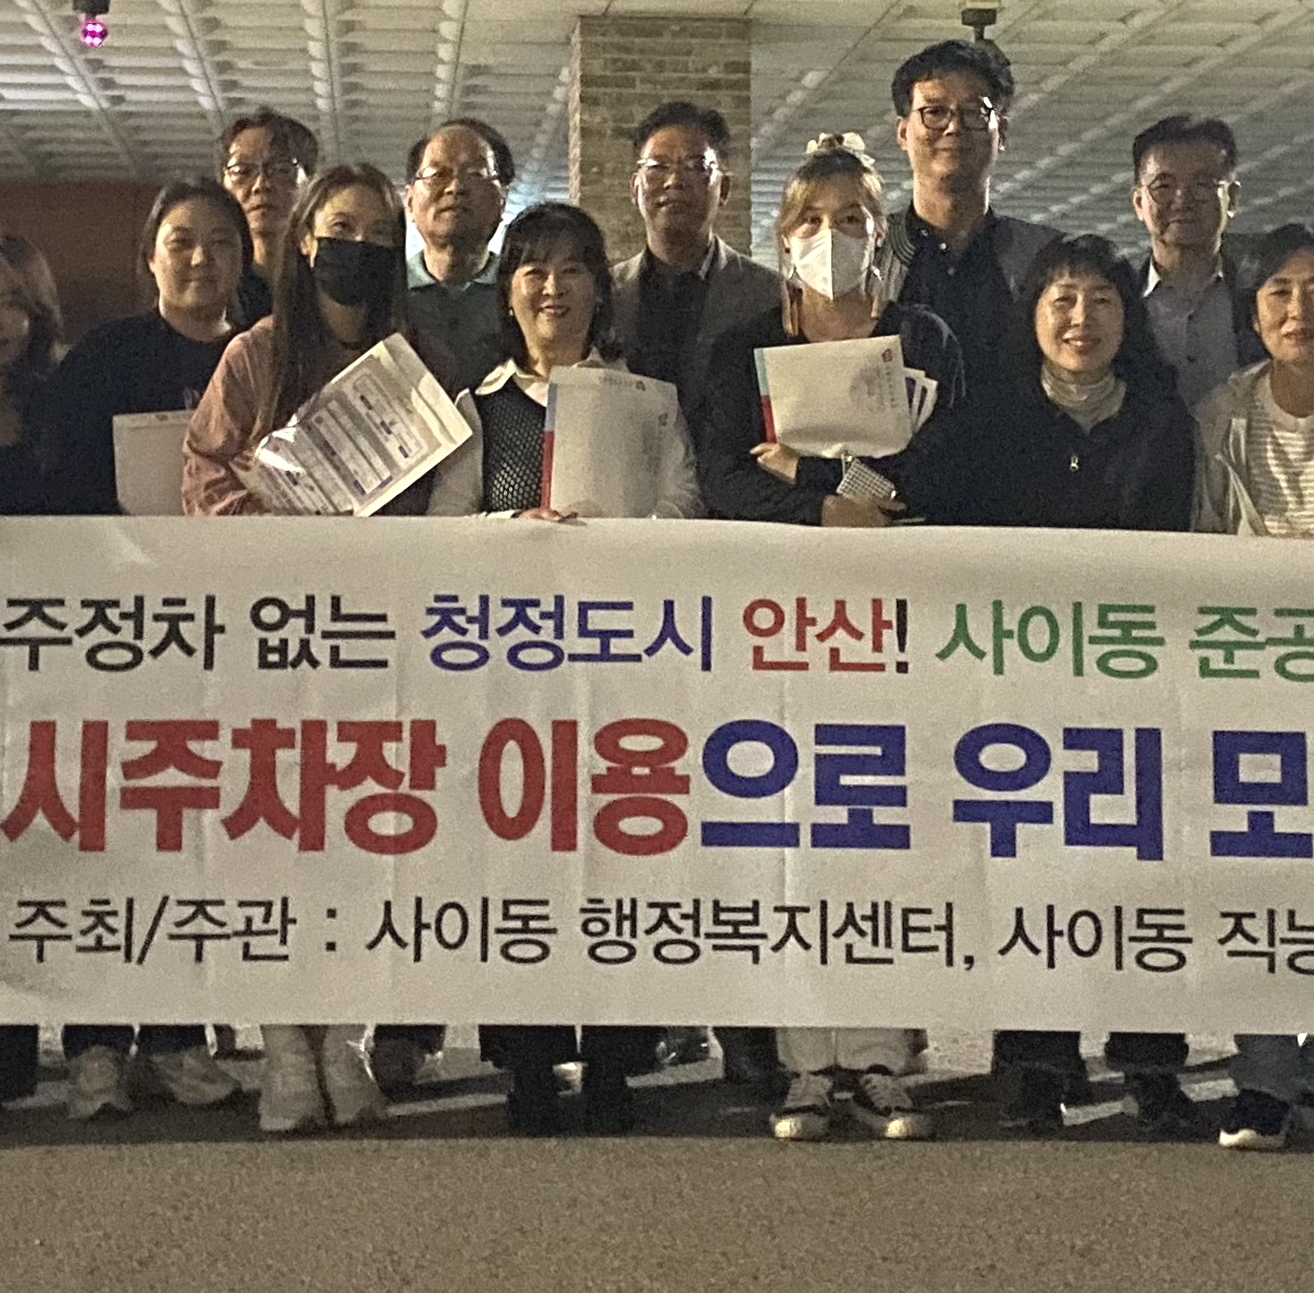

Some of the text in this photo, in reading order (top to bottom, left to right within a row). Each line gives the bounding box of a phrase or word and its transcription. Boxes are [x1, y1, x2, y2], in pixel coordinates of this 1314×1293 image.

[249, 593, 397, 671] 없는
[420, 594, 713, 673] 청정도시
[742, 596, 910, 675] 안산!
[935, 599, 1166, 679] 사이동
[477, 717, 912, 857] 이용으로
[952, 722, 1164, 862] 우리
[8, 895, 298, 966] 주최/주관
[365, 895, 559, 965] 사이동
[578, 896, 976, 972] 행정복지센터,
[997, 903, 1194, 974] 사이동
